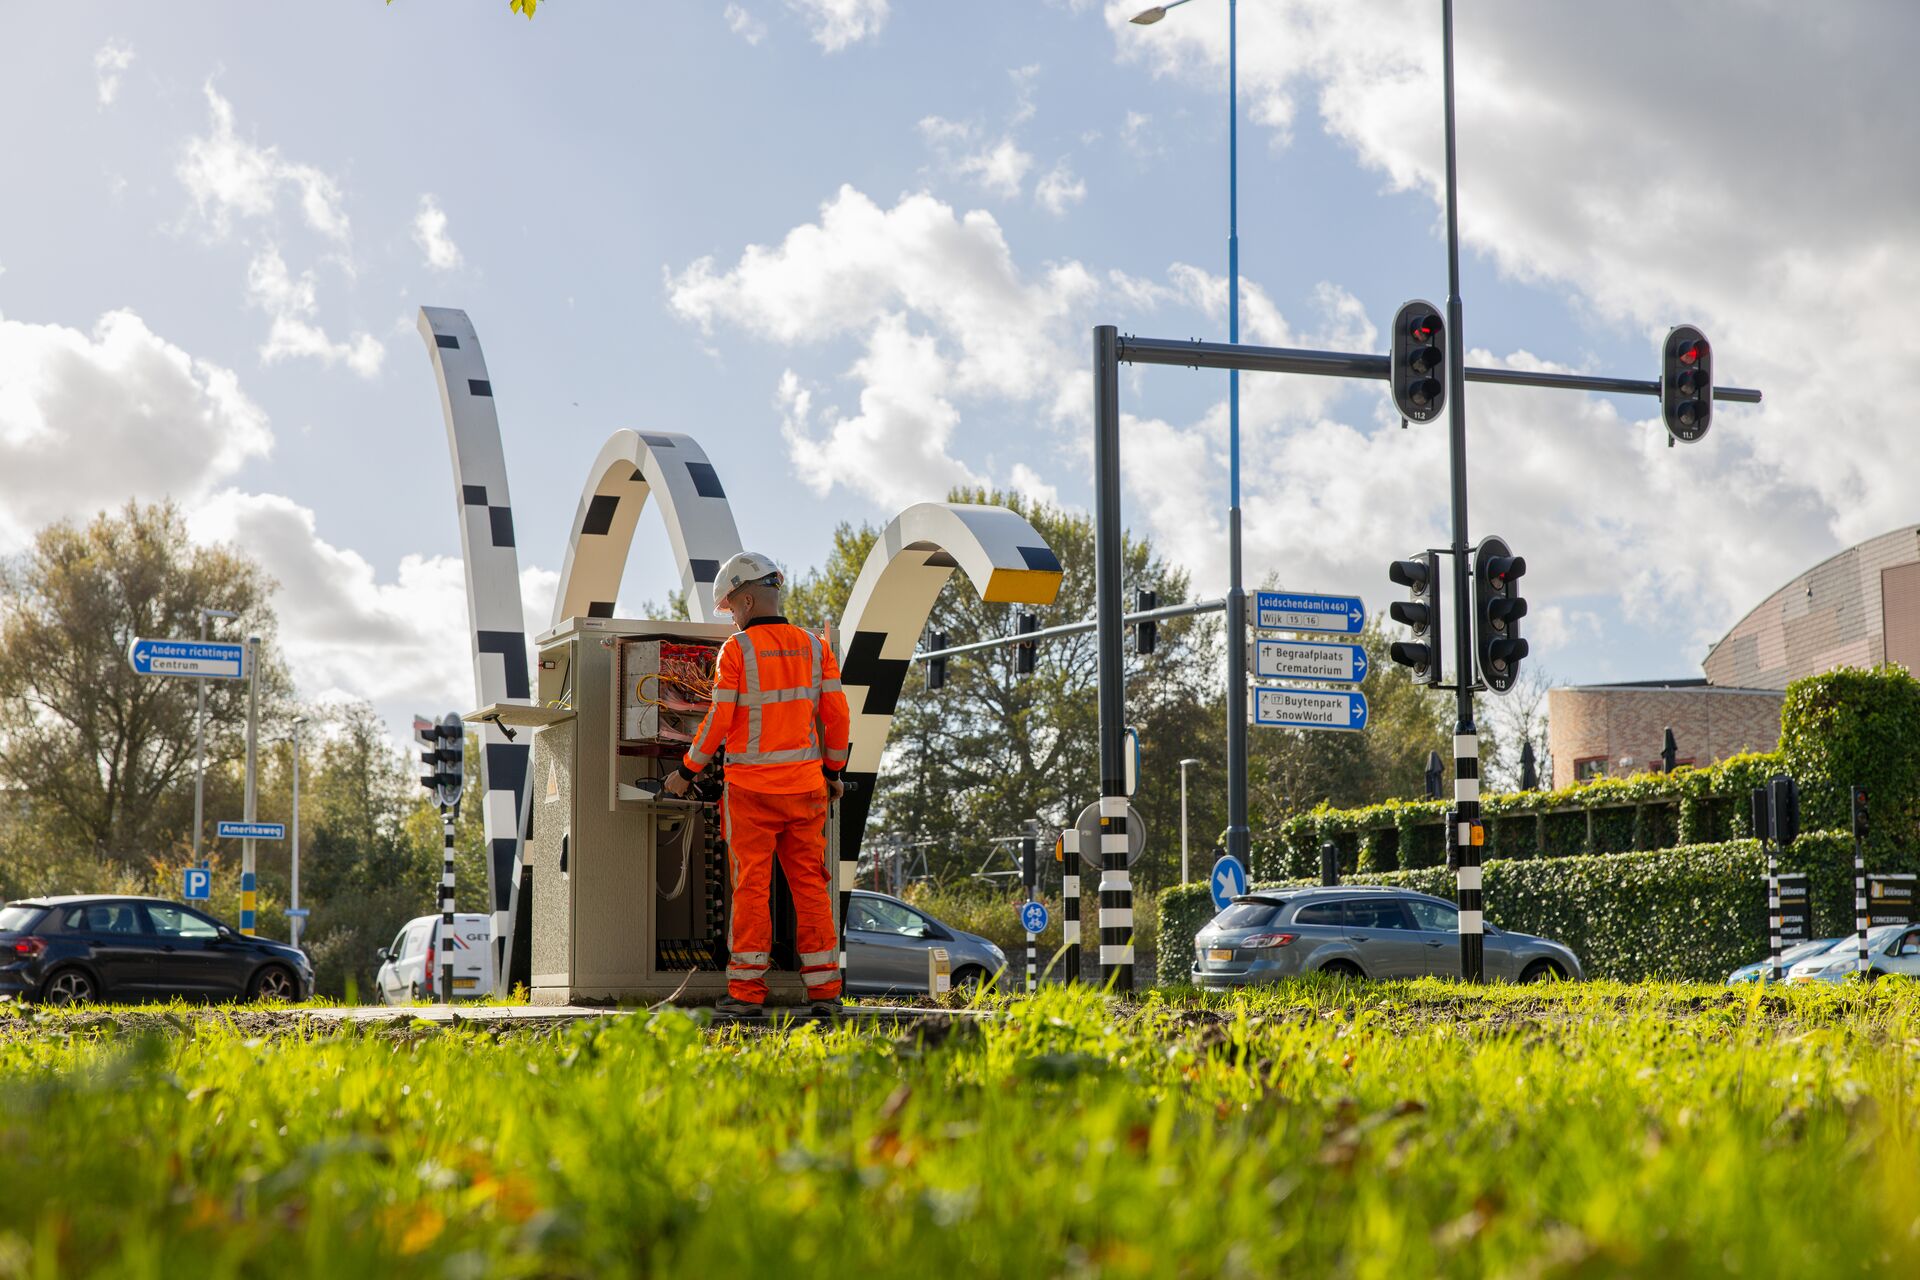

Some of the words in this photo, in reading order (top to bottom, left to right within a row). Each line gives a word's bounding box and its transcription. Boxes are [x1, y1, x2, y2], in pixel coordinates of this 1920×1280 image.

[1683, 431, 1693, 439] 11.1
[1259, 597, 1321, 610] Leidschendam
[1263, 614, 1282, 625] Wijk
[150, 645, 186, 656] Andere
[189, 648, 241, 660] richtingen
[1276, 647, 1343, 661] Begraafplaats
[152, 659, 199, 670] Centrum
[1276, 662, 1342, 675] Crematorium
[1284, 696, 1343, 709] Buytenpark
[1276, 709, 1333, 722] SnowWorld
[222, 825, 281, 837] Amerikaweg
[191, 872, 206, 896] P
